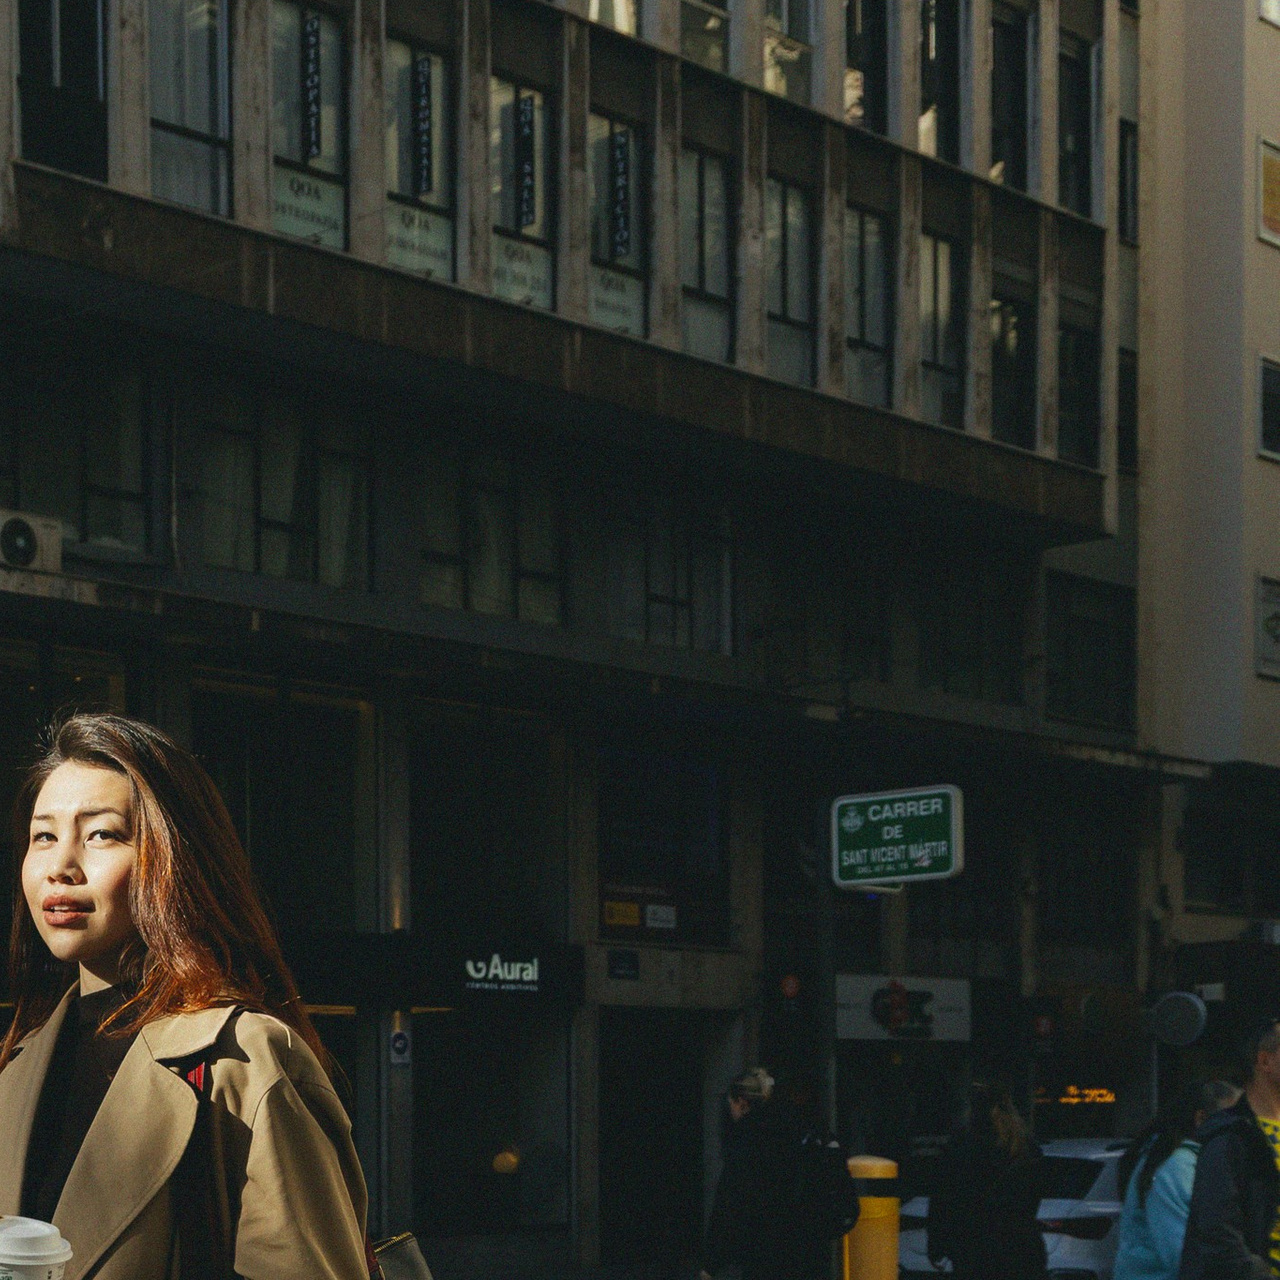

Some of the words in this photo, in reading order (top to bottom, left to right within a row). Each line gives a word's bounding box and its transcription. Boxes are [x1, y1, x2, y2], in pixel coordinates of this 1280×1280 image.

[868, 798, 943, 822] CARRER
[882, 824, 904, 840] DE
[842, 848, 868, 866] SANT
[870, 845, 906, 863] VICENT
[487, 953, 538, 982] Aural
